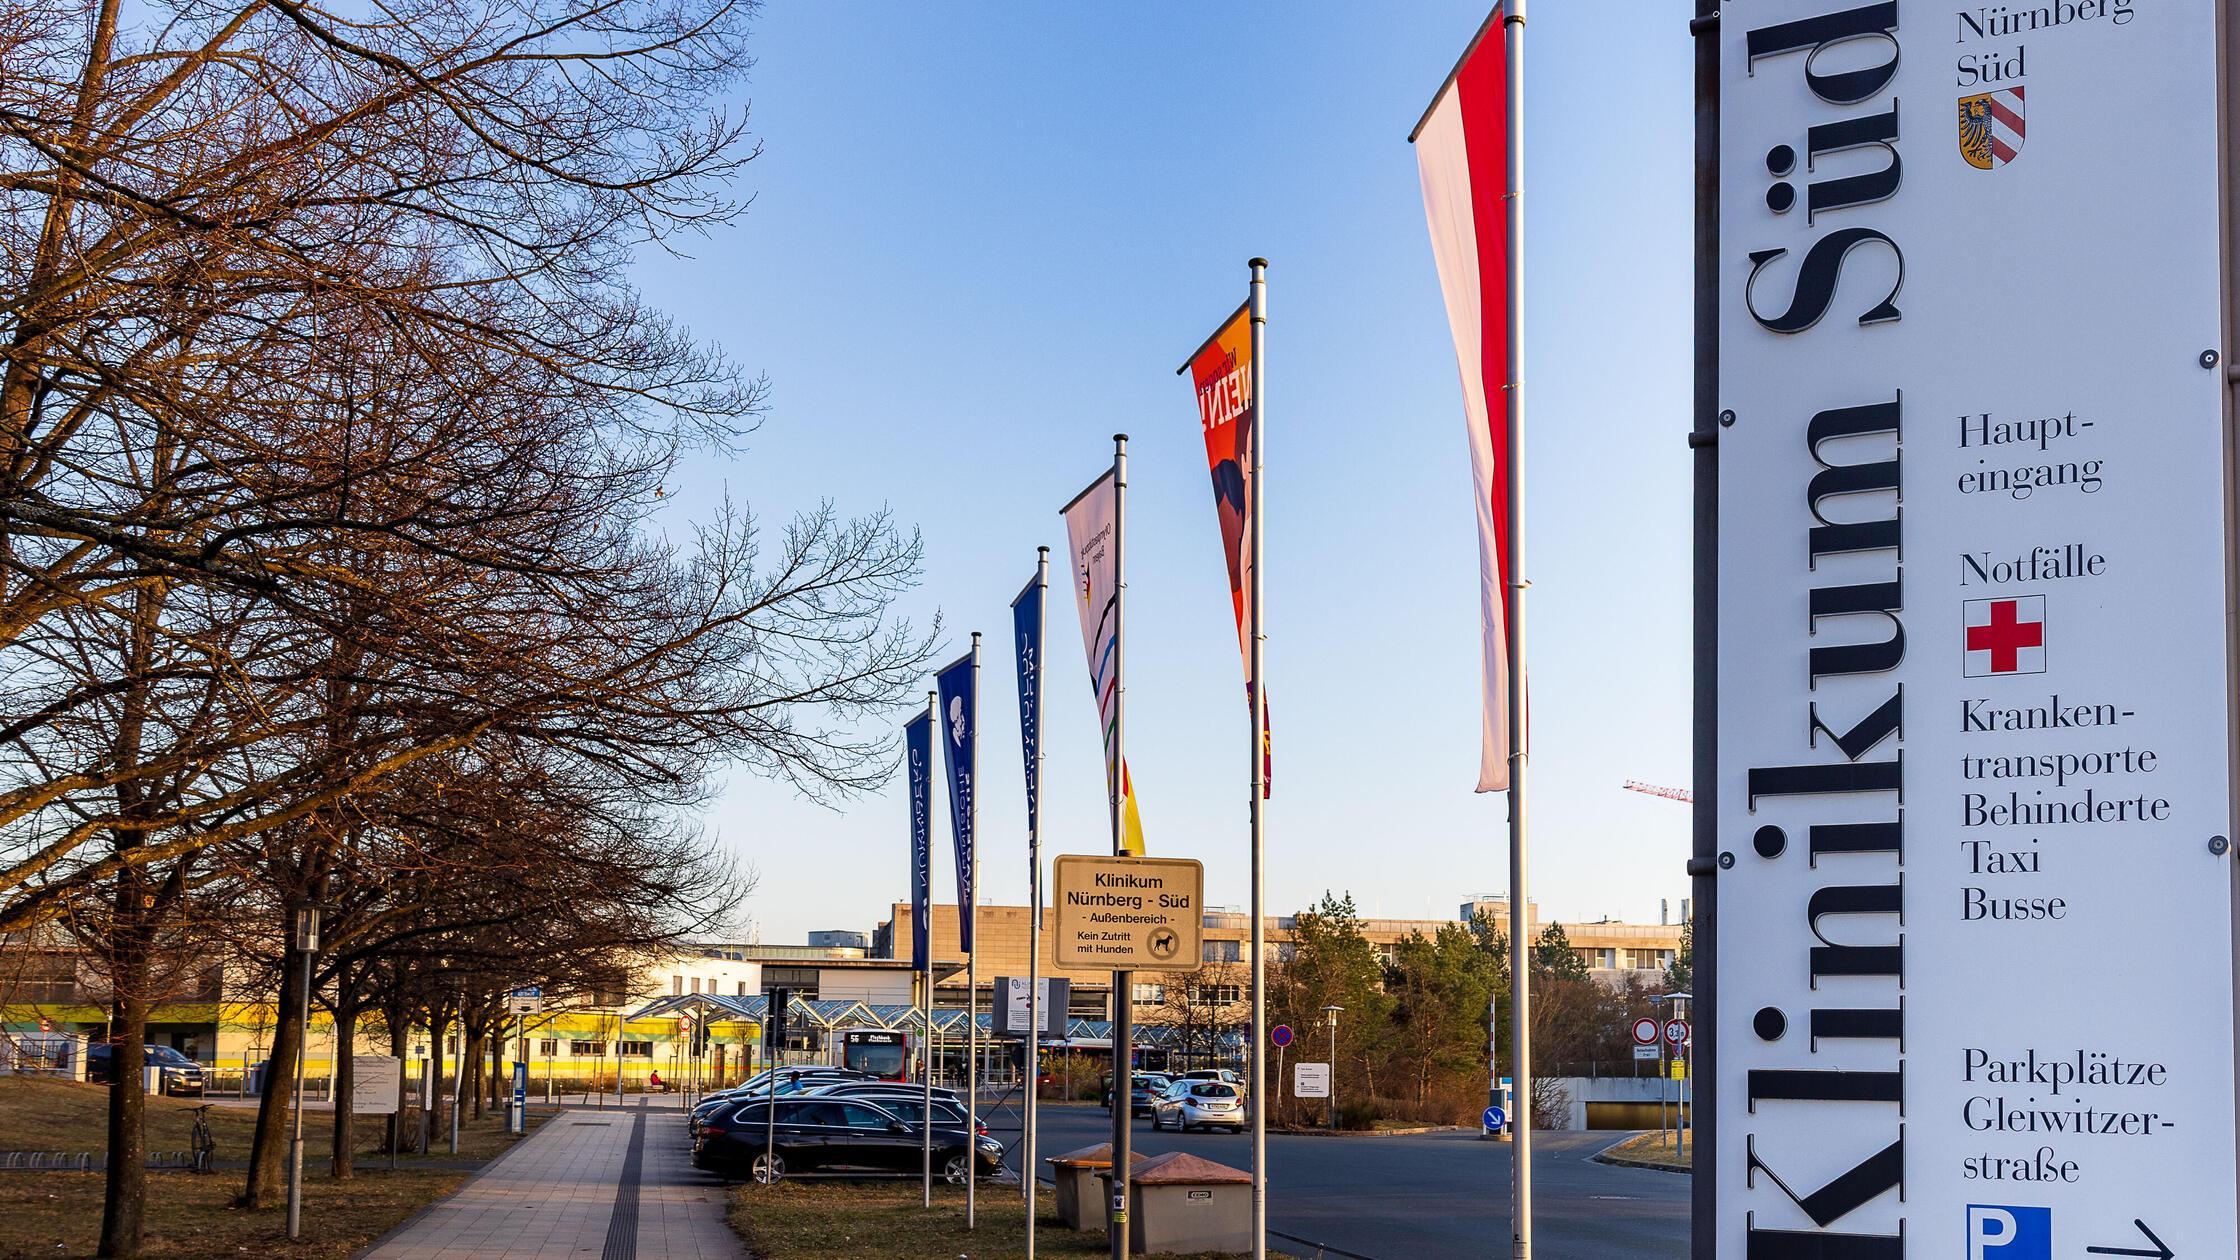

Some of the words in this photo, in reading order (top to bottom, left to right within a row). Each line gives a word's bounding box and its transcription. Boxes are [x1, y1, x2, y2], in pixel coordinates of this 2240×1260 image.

[1956, 0, 2135, 44] Nürnberg
[1957, 45, 2027, 87] Süd
[1745, 0, 1906, 336] Süd
[1957, 410, 2094, 451] Haupt-
[1958, 459, 2104, 500] eingang
[1959, 543, 2106, 587] Notfälle
[1959, 695, 2135, 733] Kranken-
[1961, 747, 2157, 787] transporte
[1747, 388, 1907, 1260] Klinikum
[1961, 788, 2171, 827] Behinderte
[1961, 838, 2041, 874] Taxi
[1067, 891, 1142, 910] Nürnberg
[1158, 893, 1190, 909] Süd
[1095, 873, 1163, 889] Klinikum
[1090, 912, 1167, 925] Außenbereich
[1961, 887, 2067, 921] Busse
[1077, 931, 1099, 941] Kein
[1101, 931, 1131, 941] Zutritt
[1077, 944, 1093, 953] mit
[1095, 944, 1134, 954] Hunden
[850, 1034, 859, 1043] 56
[1962, 1048, 2167, 1096] Parkplätze
[1963, 1096, 2175, 1136] Gleiwitzer-
[1963, 1146, 2080, 1183] straße
[1969, 1207, 2017, 1260] P
